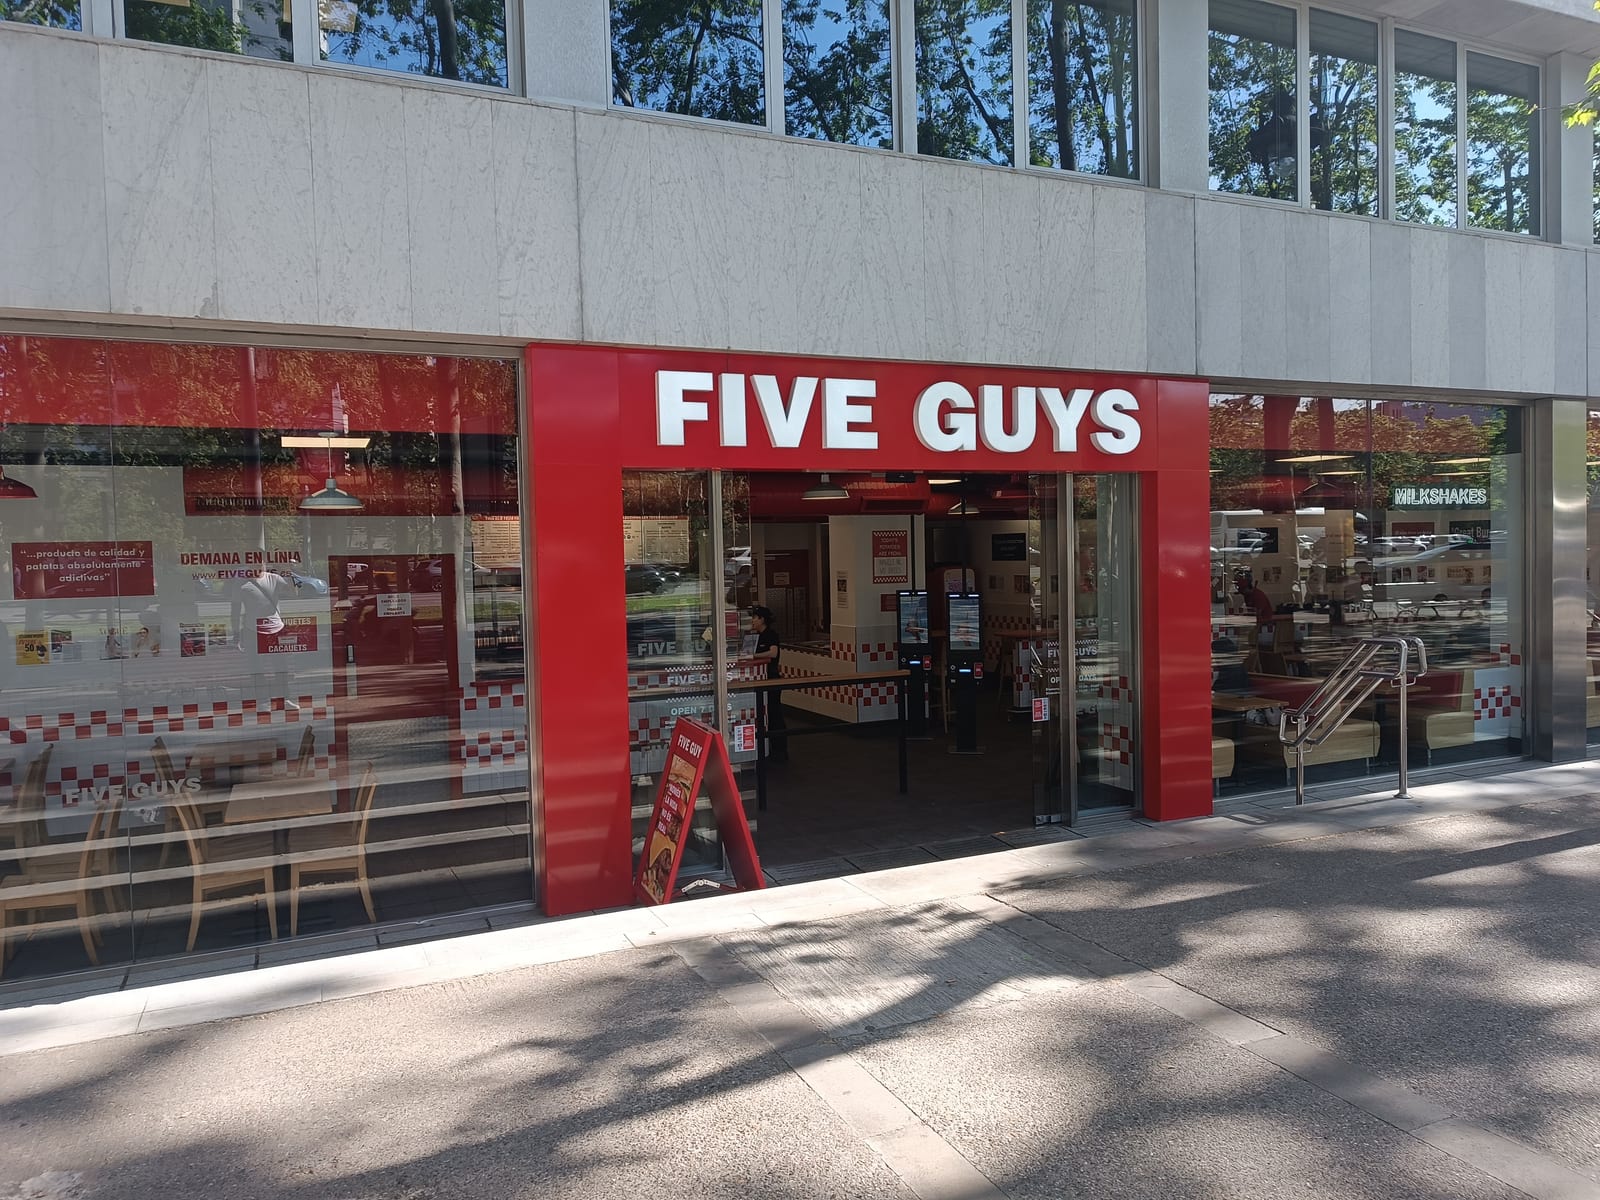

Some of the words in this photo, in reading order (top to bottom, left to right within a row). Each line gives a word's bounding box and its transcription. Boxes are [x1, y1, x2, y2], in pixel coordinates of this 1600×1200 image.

[656, 370, 879, 449] FIVE
[913, 381, 1142, 455] GUYS
[1394, 487, 1487, 505] MILKSHAKES
[84, 549, 96, 557] de
[99, 549, 136, 558] calidad
[138, 549, 145, 557] y
[181, 552, 241, 566] DEMANA
[245, 551, 262, 564] EN
[267, 548, 302, 564] LÍNIA
[26, 562, 64, 572] patatas
[67, 561, 141, 570] absolutamente
[24, 643, 35, 652] 50
[268, 644, 308, 653] CACAUETS
[637, 641, 676, 656] FIVE
[667, 675, 698, 686] FIVE
[671, 705, 698, 716] OPEN
[677, 734, 691, 751] FIVE
[65, 784, 125, 804] FIVE
[132, 777, 202, 798] GUYS
